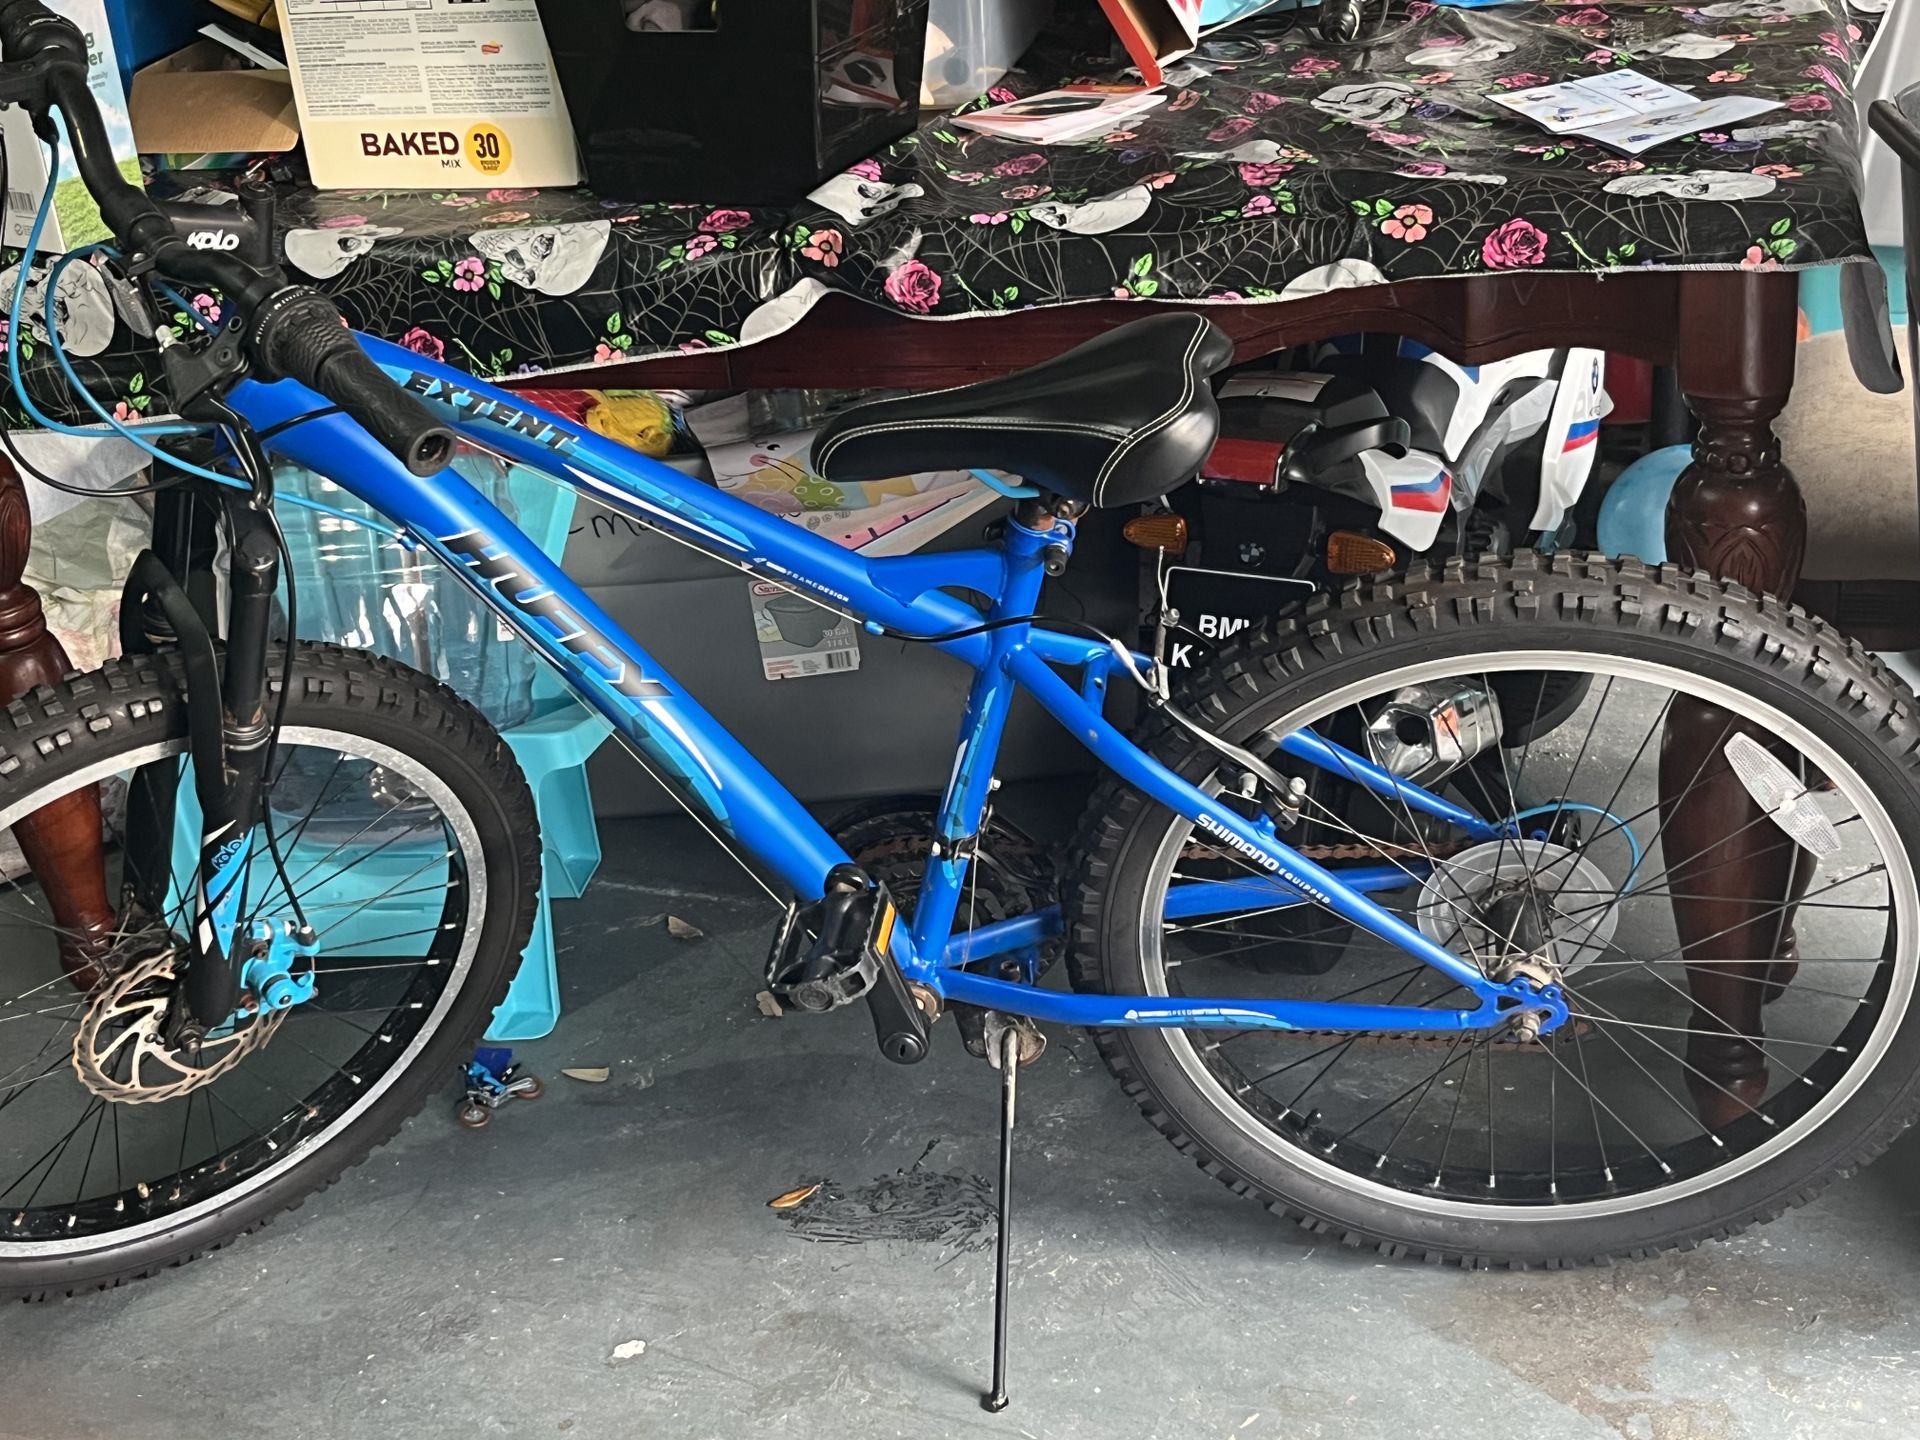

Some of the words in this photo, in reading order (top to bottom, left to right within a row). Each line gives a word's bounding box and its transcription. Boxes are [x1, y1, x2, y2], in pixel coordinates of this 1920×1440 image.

[360, 132, 460, 156] BAKED
[473, 133, 500, 159] 30
[441, 159, 462, 169] MIX
[403, 371, 581, 450] EXTENT
[1199, 614, 1250, 640] BM
[1195, 813, 1280, 871] SHIMANO
[1278, 868, 1331, 904] EQUIPPED
